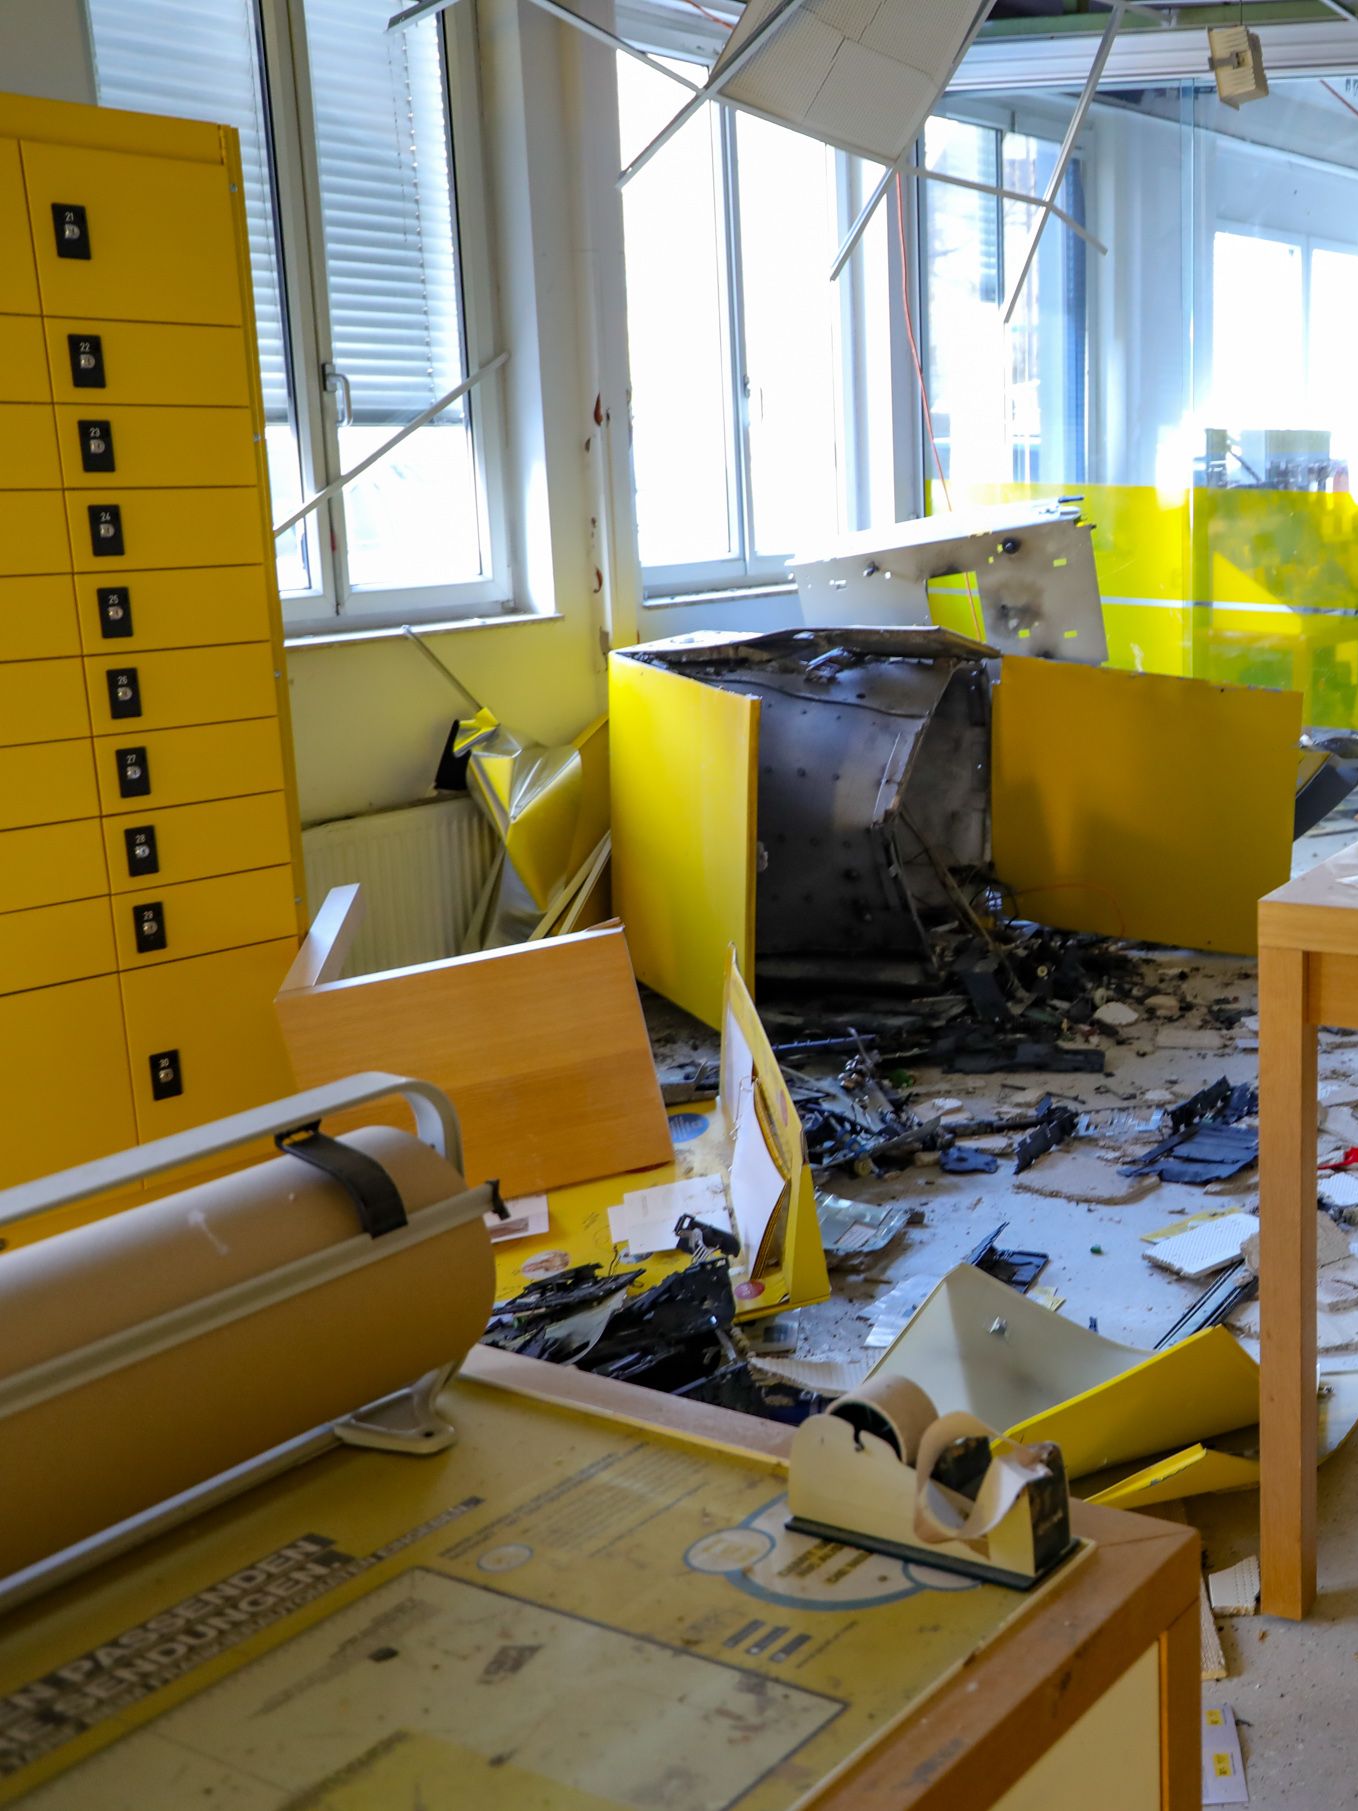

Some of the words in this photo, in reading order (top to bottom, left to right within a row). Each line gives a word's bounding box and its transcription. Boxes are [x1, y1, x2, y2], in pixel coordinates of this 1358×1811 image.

[65, 212, 75, 221] 21
[79, 342, 90, 351] 22
[90, 427, 101, 437] 23
[100, 512, 111, 521] 24
[109, 594, 119, 604] 25
[126, 754, 137, 763] 27
[60, 1538, 325, 1684] PASSENDEN
[54, 1560, 345, 1716] SENDUNGEN.
